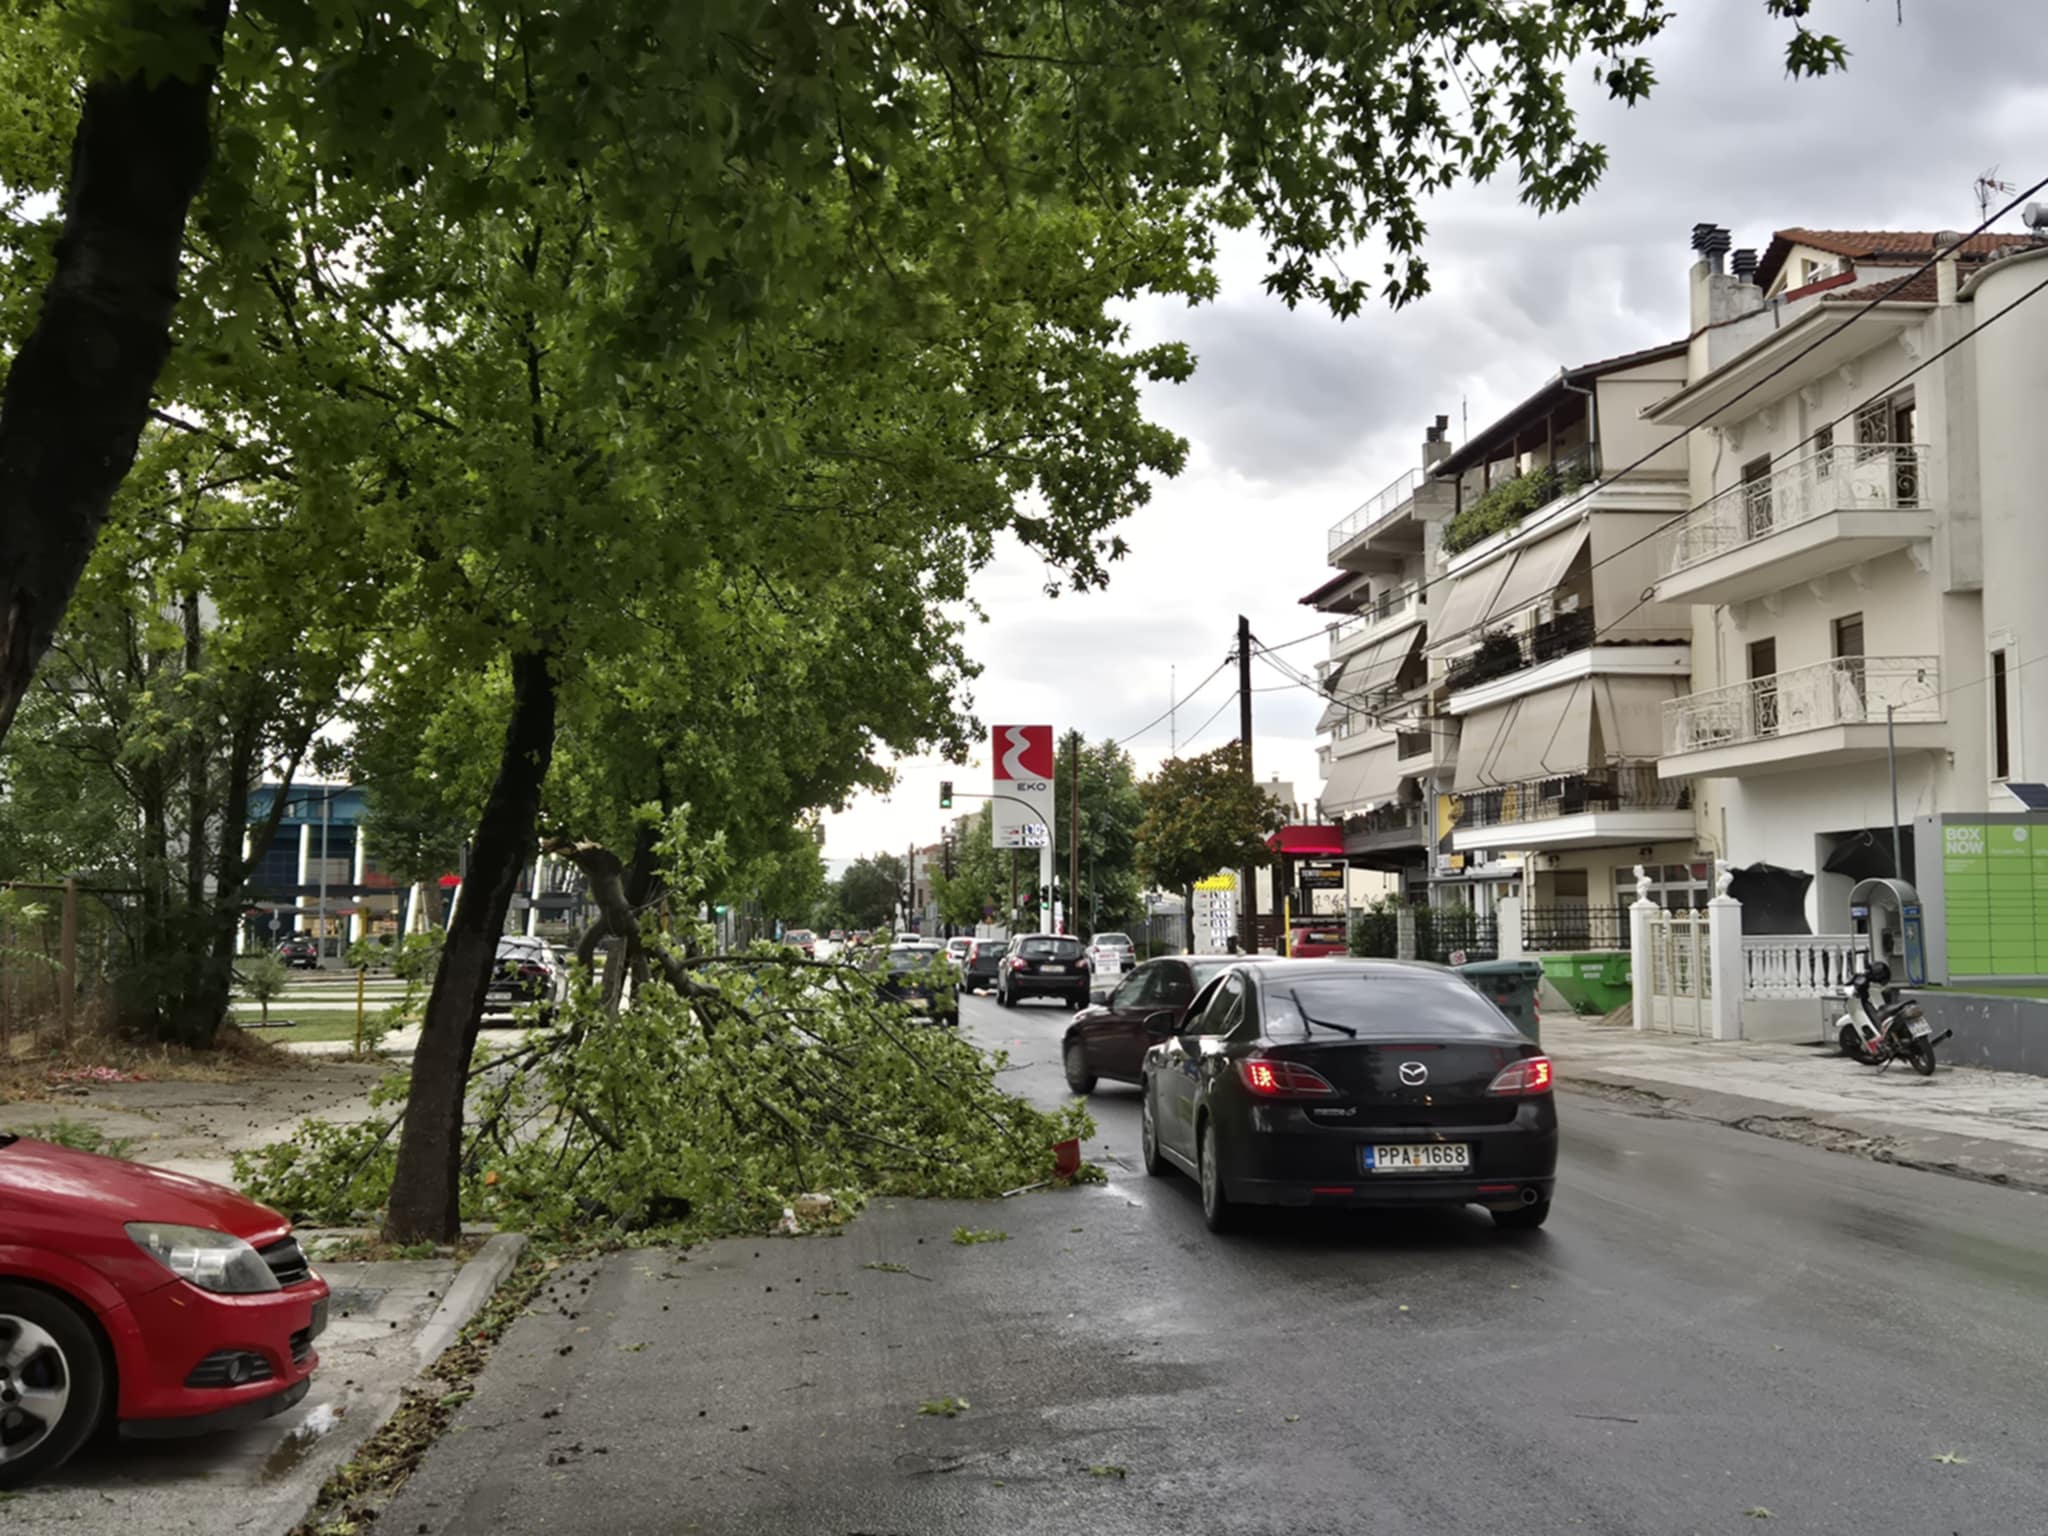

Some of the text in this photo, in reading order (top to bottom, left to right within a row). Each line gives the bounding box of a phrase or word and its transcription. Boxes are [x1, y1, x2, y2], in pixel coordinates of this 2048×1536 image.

[1017, 782, 1047, 791] EKO
[1946, 828, 1980, 841] BOX
[1946, 841, 1984, 855] NOW
[1378, 1146, 1466, 1165] PPA 1668
